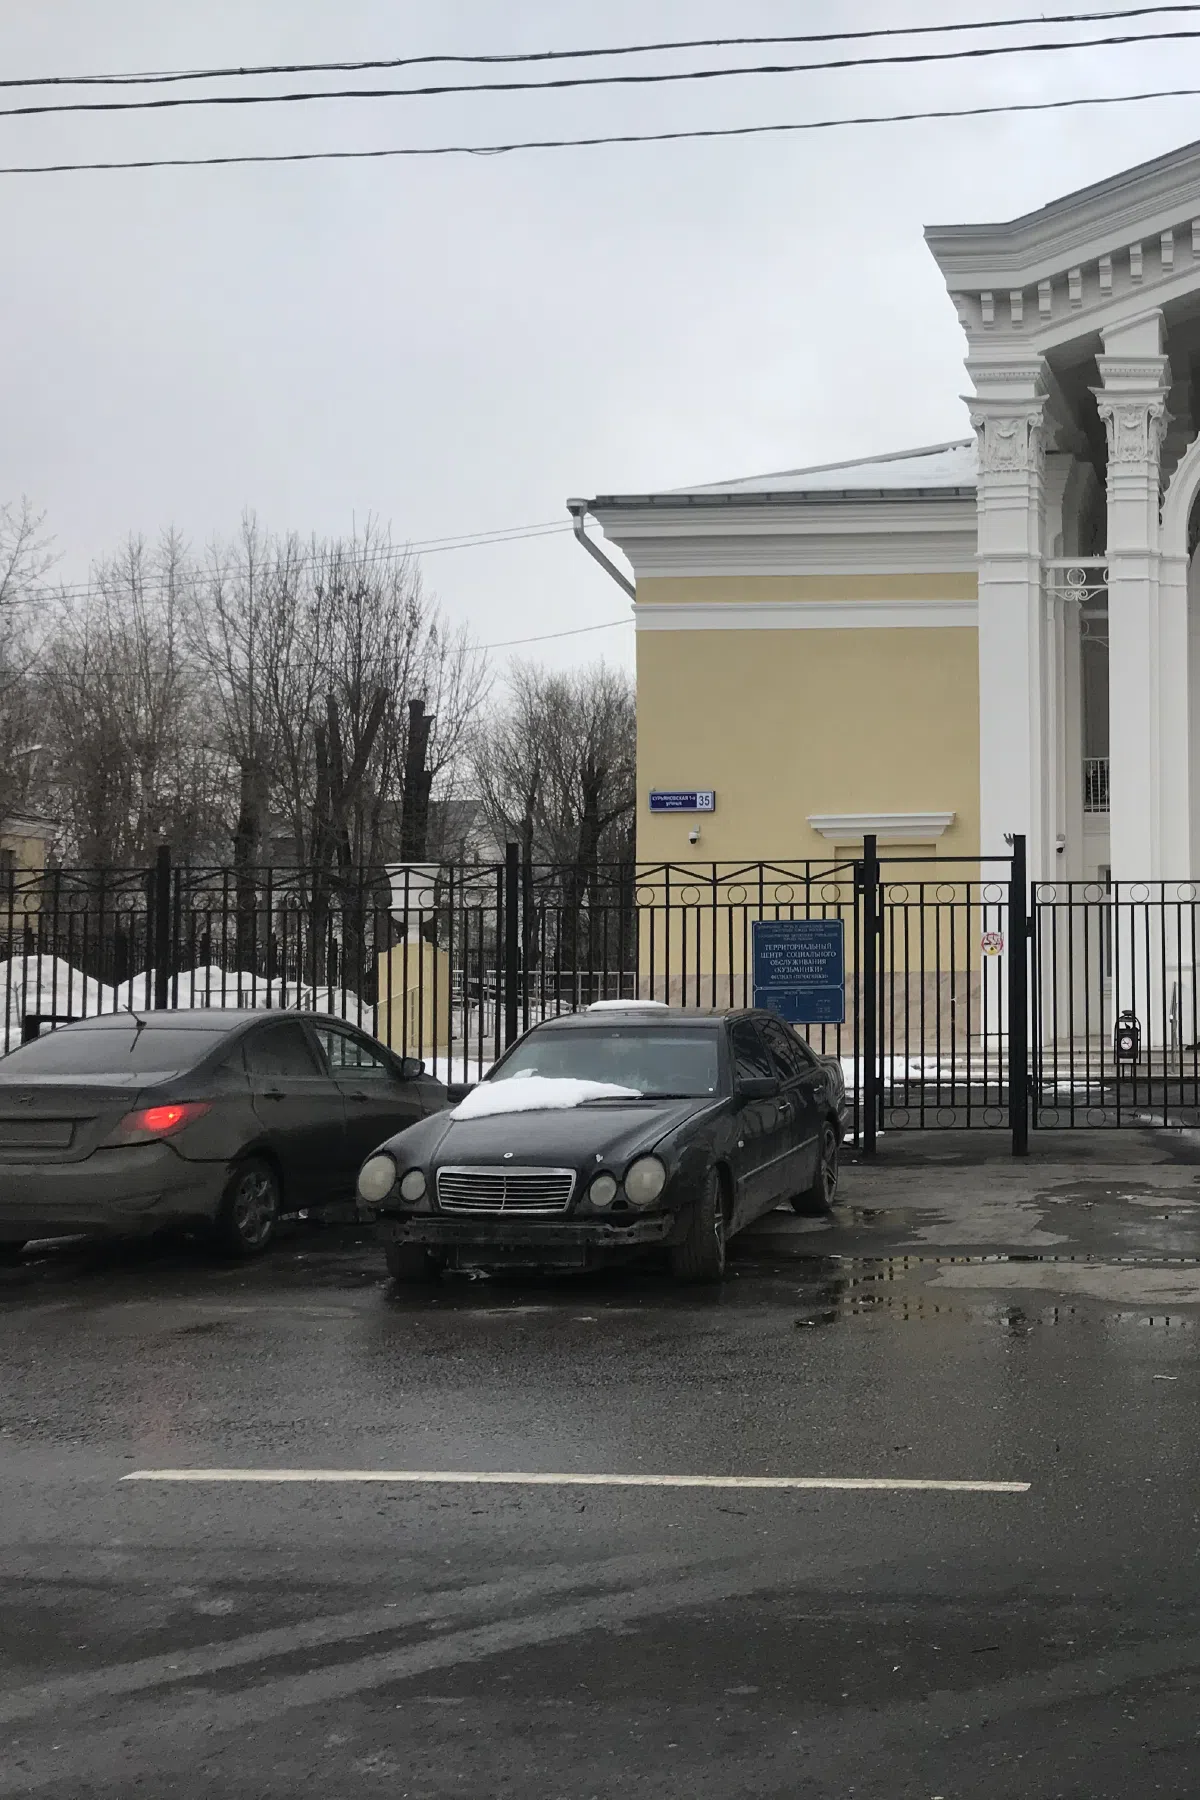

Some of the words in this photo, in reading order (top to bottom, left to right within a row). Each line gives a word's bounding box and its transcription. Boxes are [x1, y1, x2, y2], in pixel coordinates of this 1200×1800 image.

[699, 795, 710, 806] 35
[764, 942, 832, 951] ТЕРРИТОРИАЛЬНЫЙ
[760, 951, 783, 959] ЦЕНТР
[769, 958, 827, 966] ОБСЛУЖИВАНИЯ
